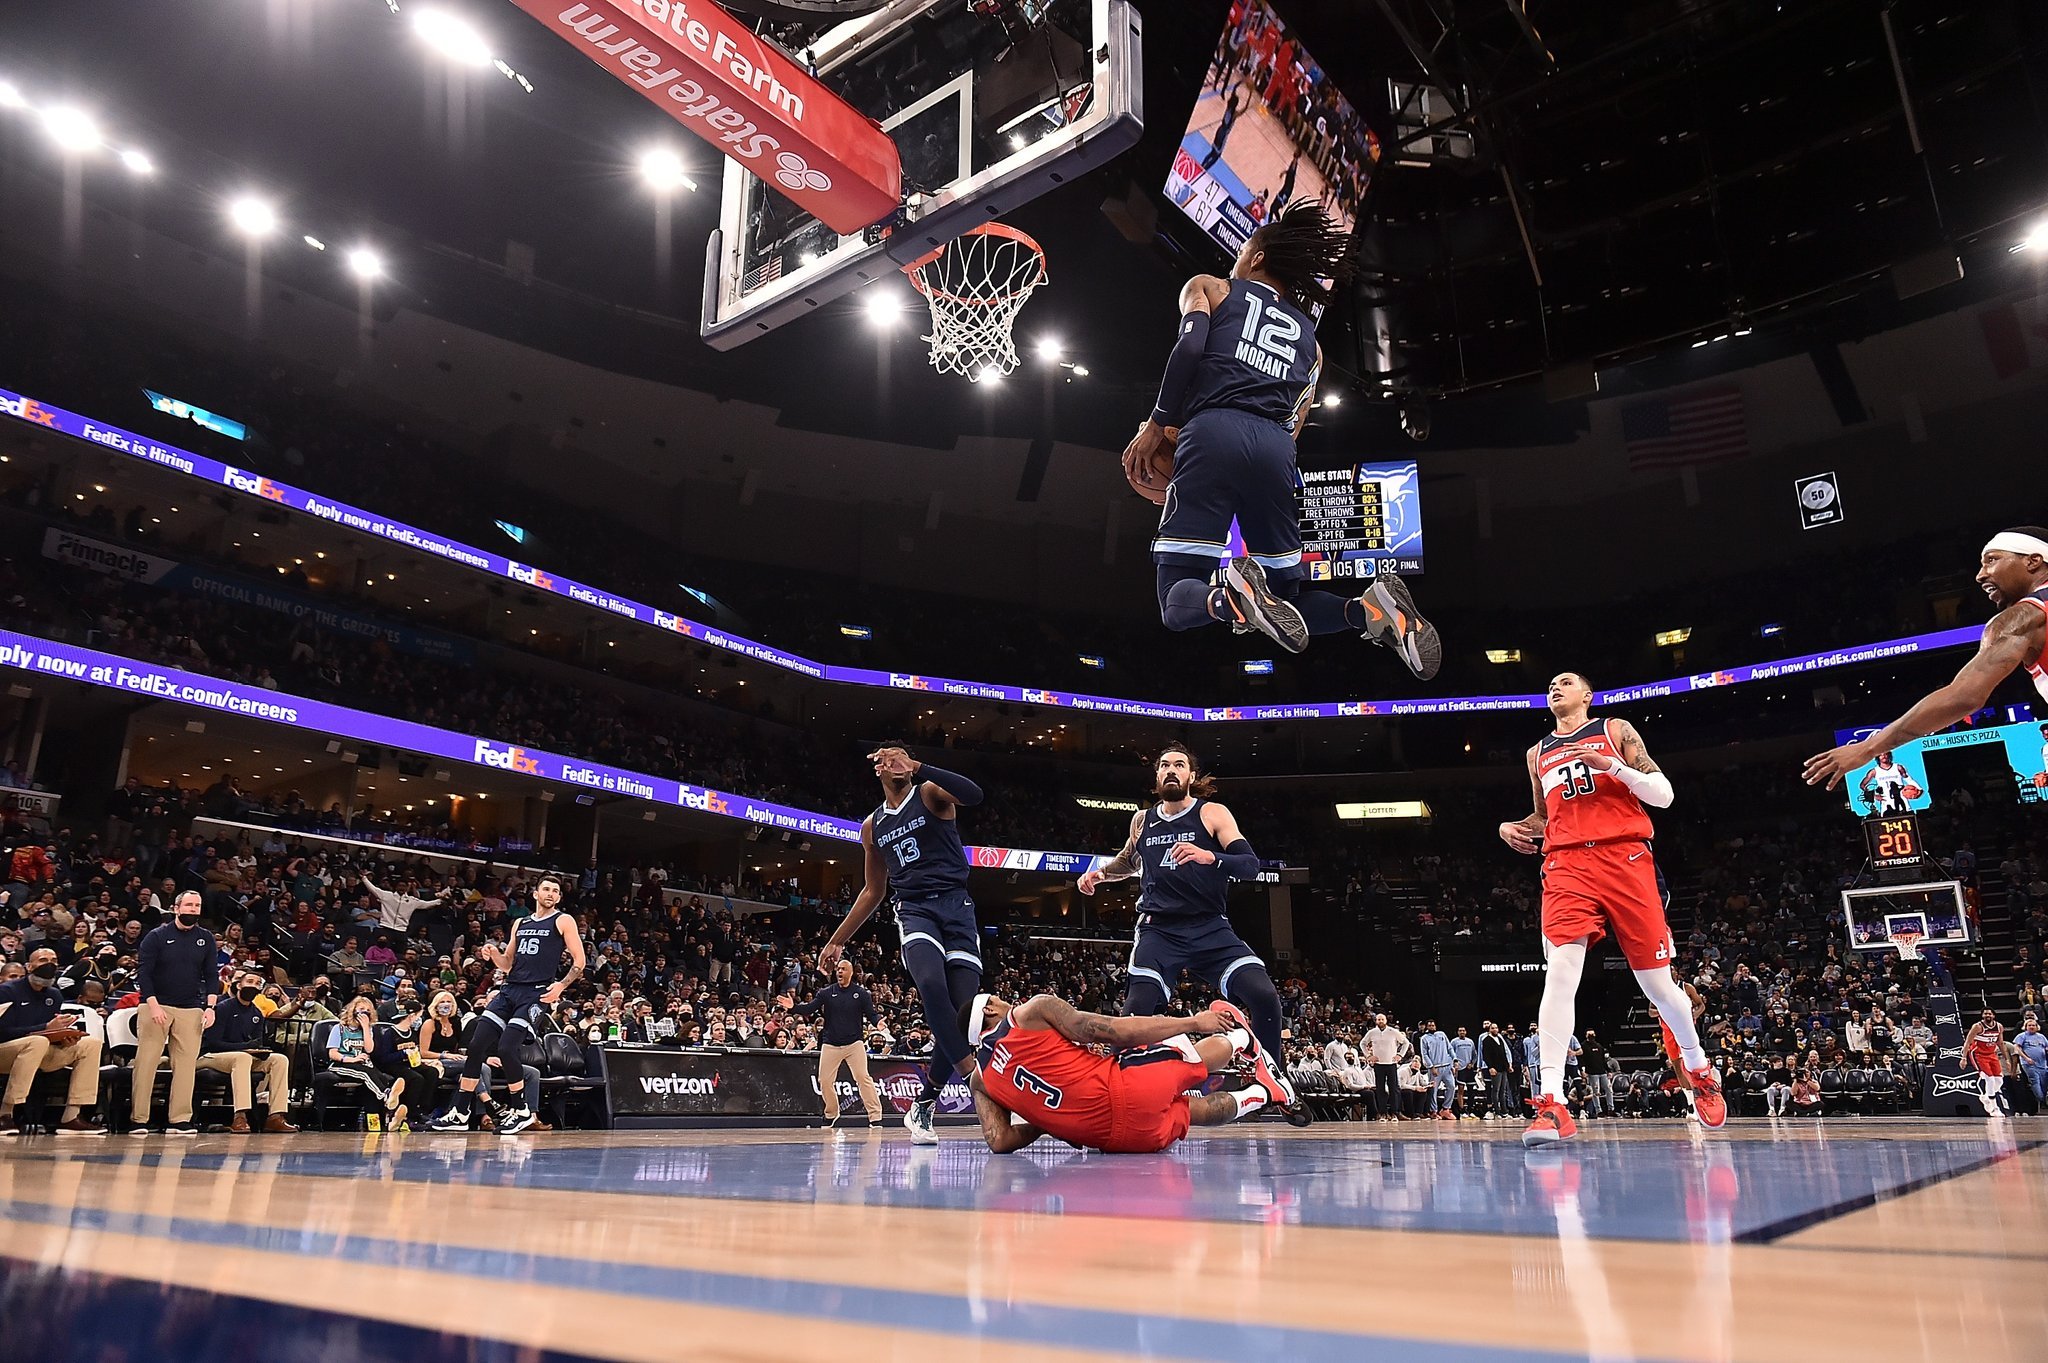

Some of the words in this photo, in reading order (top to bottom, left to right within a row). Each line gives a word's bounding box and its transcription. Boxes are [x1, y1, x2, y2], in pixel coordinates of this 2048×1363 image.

[631, 0, 710, 52] ate
[1205, 180, 1220, 204] 47
[1195, 201, 1212, 226] 67
[1245, 291, 1301, 364] 12
[1235, 341, 1291, 380] MORANT
[83, 423, 130, 451] FedEx
[132, 440, 146, 456] is
[149, 446, 194, 474] Hiring
[223, 465, 284, 502] FedEx
[1304, 472, 1326, 482] GAME
[1303, 488, 1322, 496] FIELD
[1323, 486, 1346, 495] GOALS
[1347, 485, 1354, 493] %
[1361, 484, 1376, 493] 47%
[1811, 490, 1825, 501] 50
[1303, 499, 1321, 507] FREE
[1322, 498, 1348, 506] THROW
[1349, 496, 1355, 504] %
[1305, 510, 1323, 518] FREE
[1324, 508, 1354, 517] THROWS
[306, 498, 342, 522] Apply
[343, 515, 371, 531] now
[372, 522, 385, 535] at
[386, 525, 489, 569] FedEx.com/careers
[1313, 520, 1329, 529] 3-PT
[1330, 519, 1341, 527] FG
[1341, 519, 1348, 527] %
[1317, 531, 1333, 540] 3-PT
[1334, 530, 1345, 539] FG
[57, 533, 149, 576] Pinnacle
[1303, 543, 1329, 552] POINTS
[1330, 542, 1338, 551] IN
[1339, 540, 1360, 550] PAINT
[1367, 540, 1378, 549] 40
[507, 560, 553, 589] FedEx
[1333, 561, 1353, 576] 105
[1378, 559, 1397, 574] 132
[1400, 561, 1420, 570] FINAL
[191, 576, 251, 603] OFFICIAL
[256, 594, 290, 614] BANK
[315, 610, 337, 627] THE
[341, 617, 401, 643] GRIZZES
[569, 585, 598, 603] FedEx
[599, 594, 608, 606] is
[608, 598, 637, 618] Hiring
[653, 610, 692, 635] FedEx
[704, 630, 728, 648] Apply
[728, 641, 746, 651] now
[746, 645, 755, 654] at
[755, 646, 821, 677] FedEx.com/careers
[1751, 663, 1781, 679] Apply
[1781, 662, 1804, 673] now
[1805, 660, 1817, 670] at
[1817, 641, 1918, 667] FedEx.com/careers
[37, 653, 86, 677] now
[90, 664, 113, 683] at
[116, 667, 298, 722] FedEx.com/careers
[889, 673, 929, 690] FedEx
[1689, 671, 1734, 690] FedEx
[944, 682, 969, 694] FedEx
[970, 686, 979, 696] is
[980, 687, 1005, 700] Hiring
[1022, 688, 1059, 705] FedEx
[1603, 691, 1631, 704] FedEx
[1632, 689, 1641, 700] is
[1642, 685, 1671, 699] Hiring
[1071, 697, 1095, 710] Apply
[1095, 702, 1113, 711] now
[1113, 703, 1123, 712] at
[1123, 703, 1193, 720] FedEx.com/careers
[1204, 708, 1243, 721] FedEx
[1257, 708, 1283, 718] FedEx
[1284, 708, 1292, 718] is
[1293, 707, 1319, 718] Hiring
[1337, 702, 1377, 715] FedEx
[1391, 703, 1416, 714] Apply
[1417, 703, 1437, 712] now
[1438, 703, 1448, 711] at
[1448, 699, 1531, 711] FedEx.com/careers
[1922, 739, 1940, 748] SLIM
[1946, 734, 1978, 746] HUSKY'S
[1979, 730, 2000, 741] PIZZA
[474, 740, 539, 774] FedEx
[562, 764, 601, 785] FedEx
[603, 774, 615, 789] is
[616, 776, 653, 800] Hiring
[1558, 761, 1596, 800] 33
[678, 785, 728, 813] FedEx
[745, 804, 774, 824] Apply
[775, 814, 798, 828] now
[799, 818, 810, 831] at
[810, 819, 861, 841] FedEx.com/
[877, 815, 927, 848] GRIZZLIES
[1881, 820, 1911, 833] 7:47
[1146, 831, 1196, 847] GRIZZLIES
[1879, 833, 1911, 857] 20
[892, 837, 920, 868] 13
[1017, 853, 1031, 867] 47
[1046, 853, 1075, 863] TIMEOUTS:
[1075, 856, 1080, 864] 4
[1159, 848, 1179, 870] 4
[1887, 856, 1921, 866] TISSOT
[1045, 862, 1065, 871] FOULS:
[1266, 872, 1280, 883] QTR
[517, 938, 540, 955] 46
[1481, 964, 1516, 972] HIBBETT
[1521, 963, 1540, 972] CITY
[991, 1043, 1013, 1074] BEAL
[640, 1072, 714, 1094] verizon
[1013, 1065, 1063, 1110] 3
[1938, 1079, 1977, 1089] SONIC
